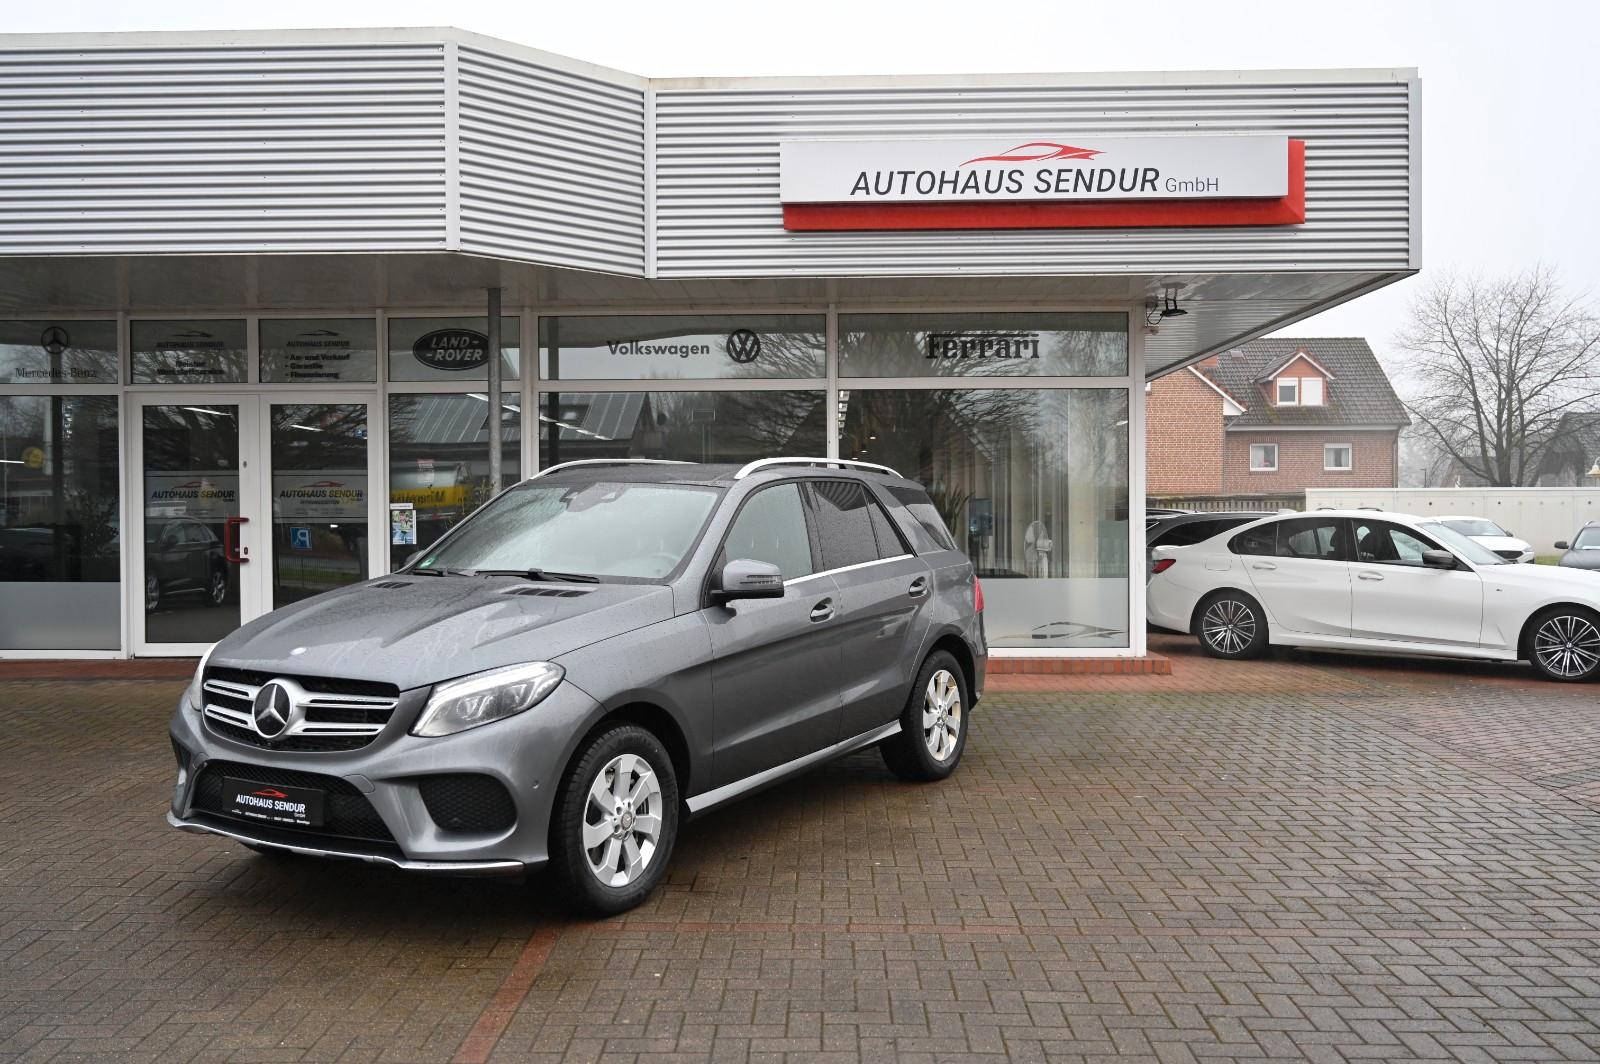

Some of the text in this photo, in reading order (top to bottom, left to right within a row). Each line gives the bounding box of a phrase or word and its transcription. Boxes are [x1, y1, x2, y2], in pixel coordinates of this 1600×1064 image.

[850, 168, 1219, 195] AUTOHAUS SENDUR GmbH
[607, 340, 710, 358] Volkswagen
[926, 333, 1040, 359] Ferrari
[15, 367, 97, 378] Mercedes-Benz
[152, 490, 235, 499] AUTOHAUS SENDUR
[280, 489, 363, 498] AUTOHAUS SENDUR
[236, 794, 306, 813] AUTOHAUS SENDUR
